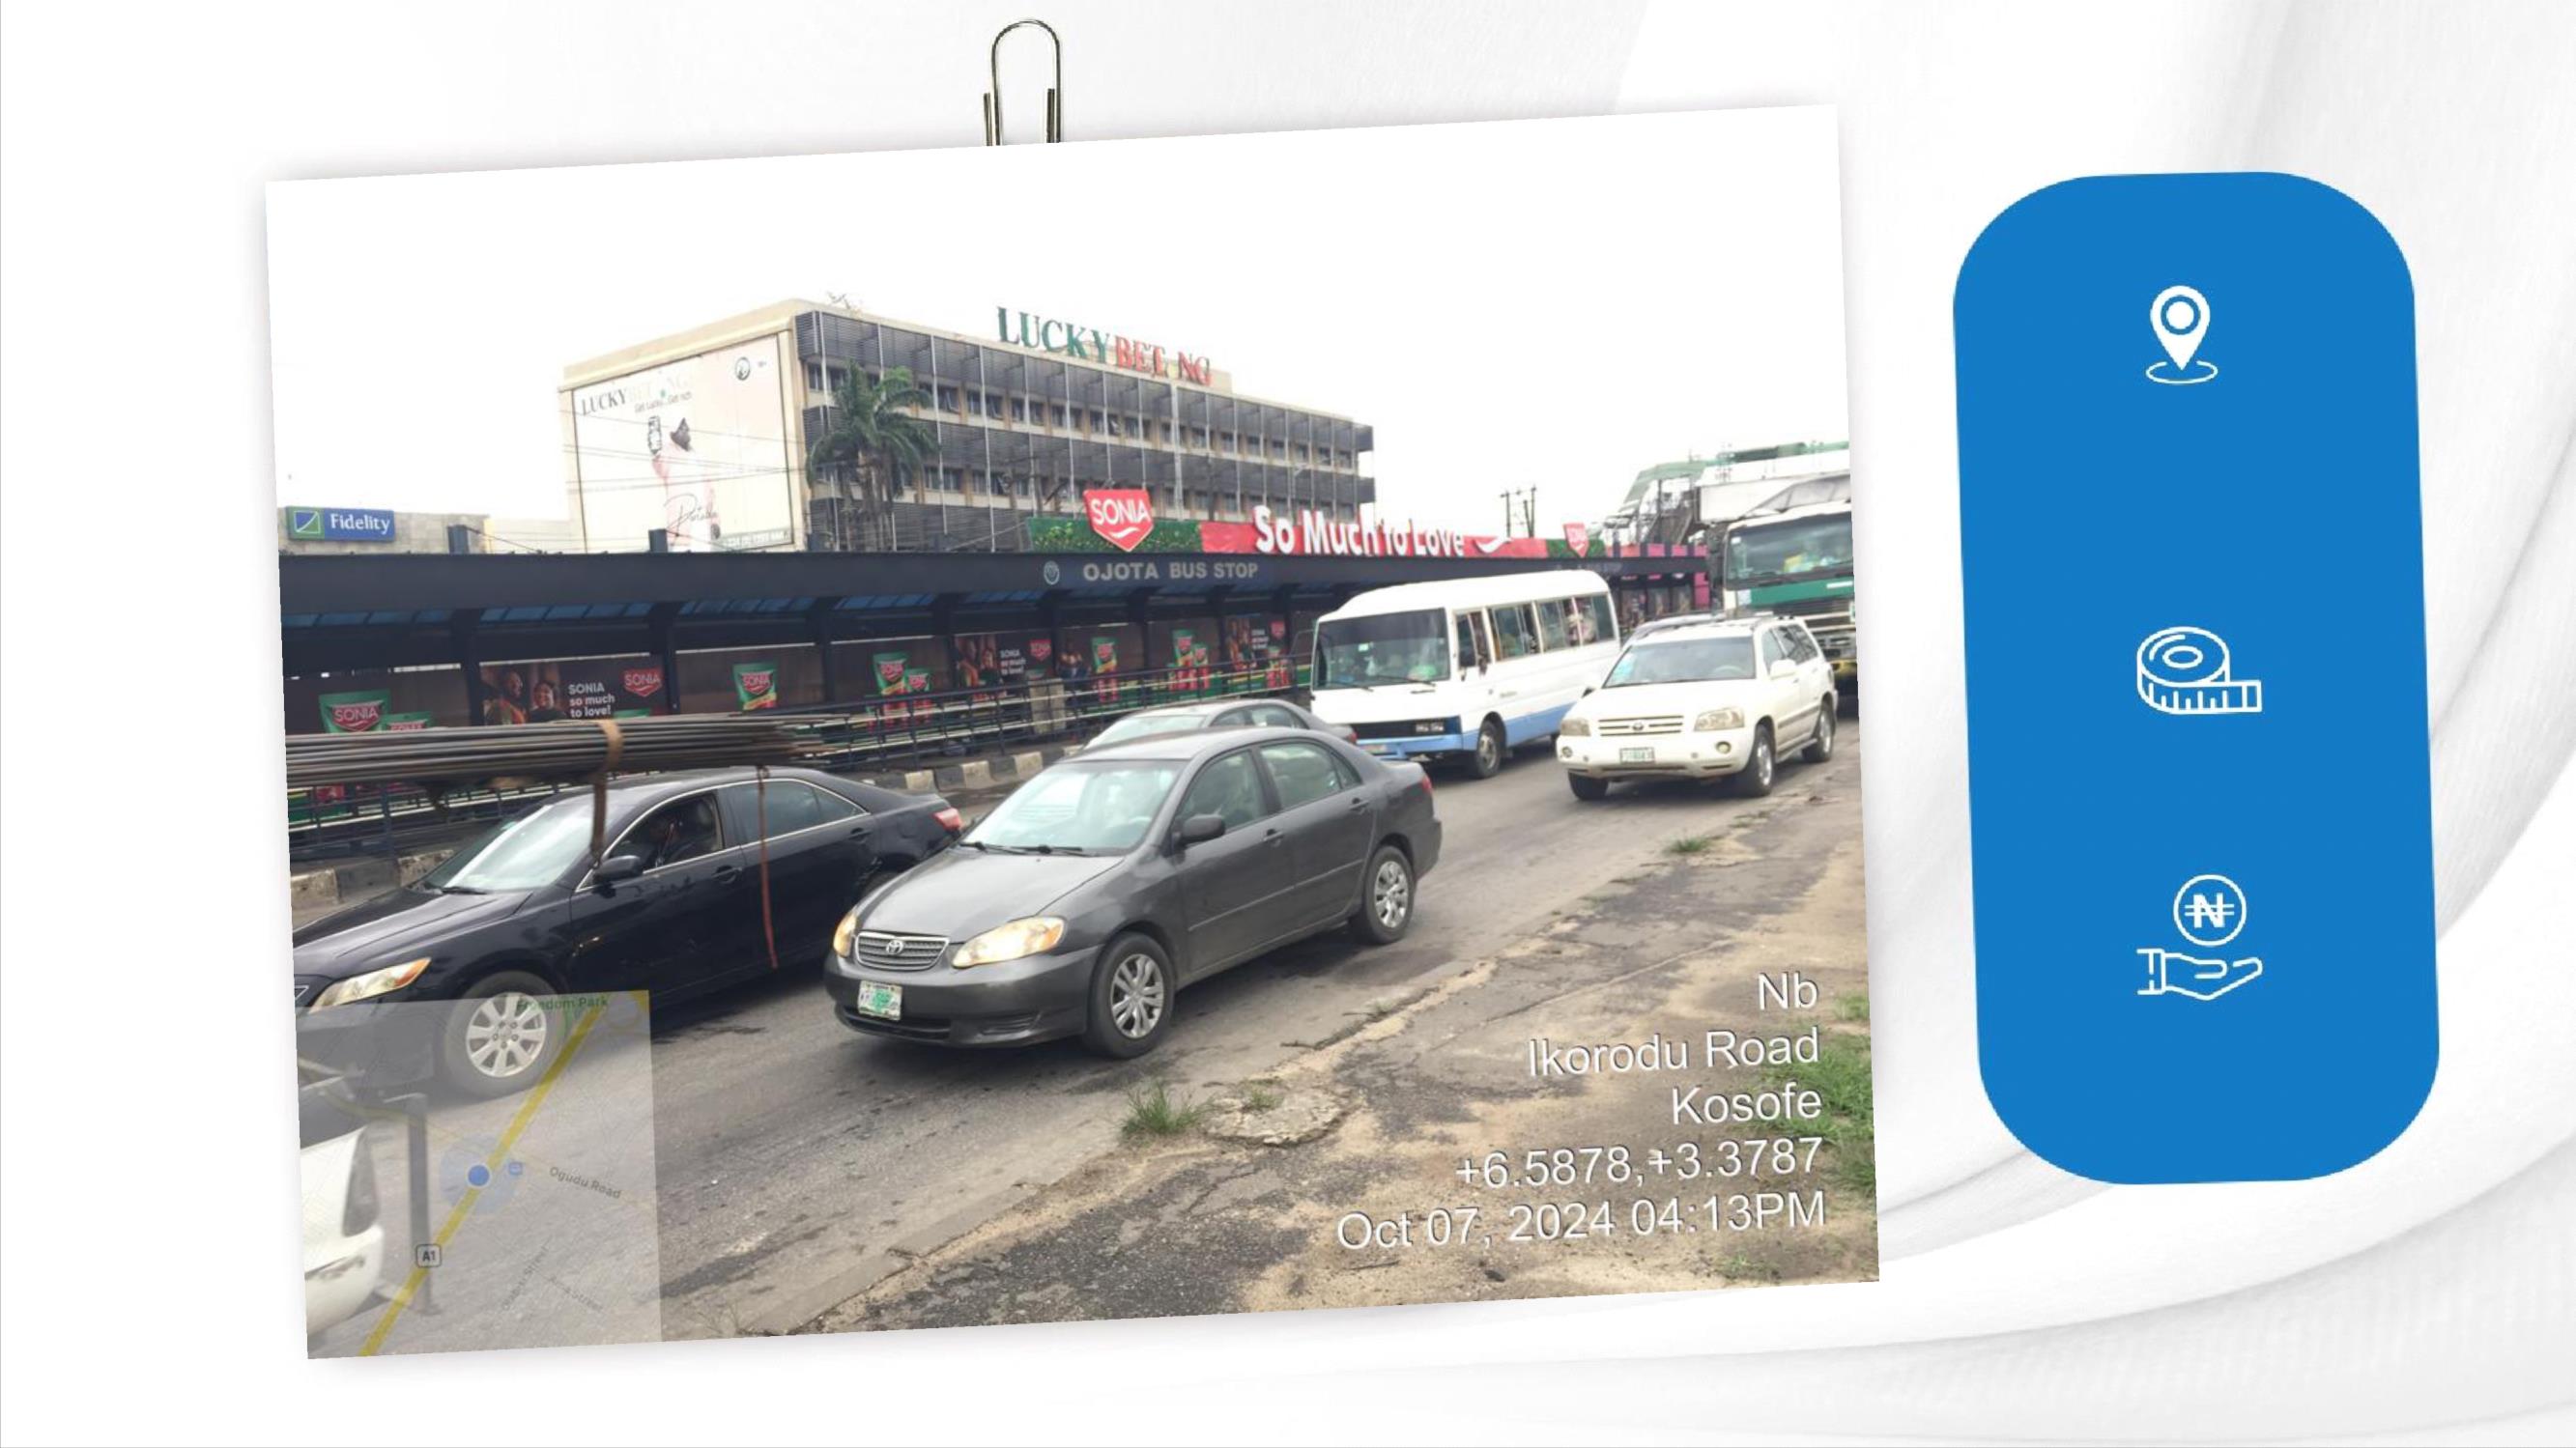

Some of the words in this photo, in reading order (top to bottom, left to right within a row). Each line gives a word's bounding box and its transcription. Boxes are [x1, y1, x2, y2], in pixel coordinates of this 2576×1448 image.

[1091, 497, 1152, 525] SONIA
[329, 513, 390, 535] Fidelity
[1253, 504, 1295, 555] So
[1302, 501, 1379, 556] Much
[1410, 519, 1464, 557] Love
[1083, 562, 1159, 582] OJOTA
[1169, 562, 1208, 579] BUS
[1214, 562, 1258, 579] STOP
[624, 672, 662, 686] SONIA
[567, 682, 605, 696] SONIA
[569, 696, 584, 707] so
[585, 693, 615, 706] much
[333, 706, 380, 723] SONIA
[569, 708, 583, 719] to
[584, 704, 612, 718] love!
